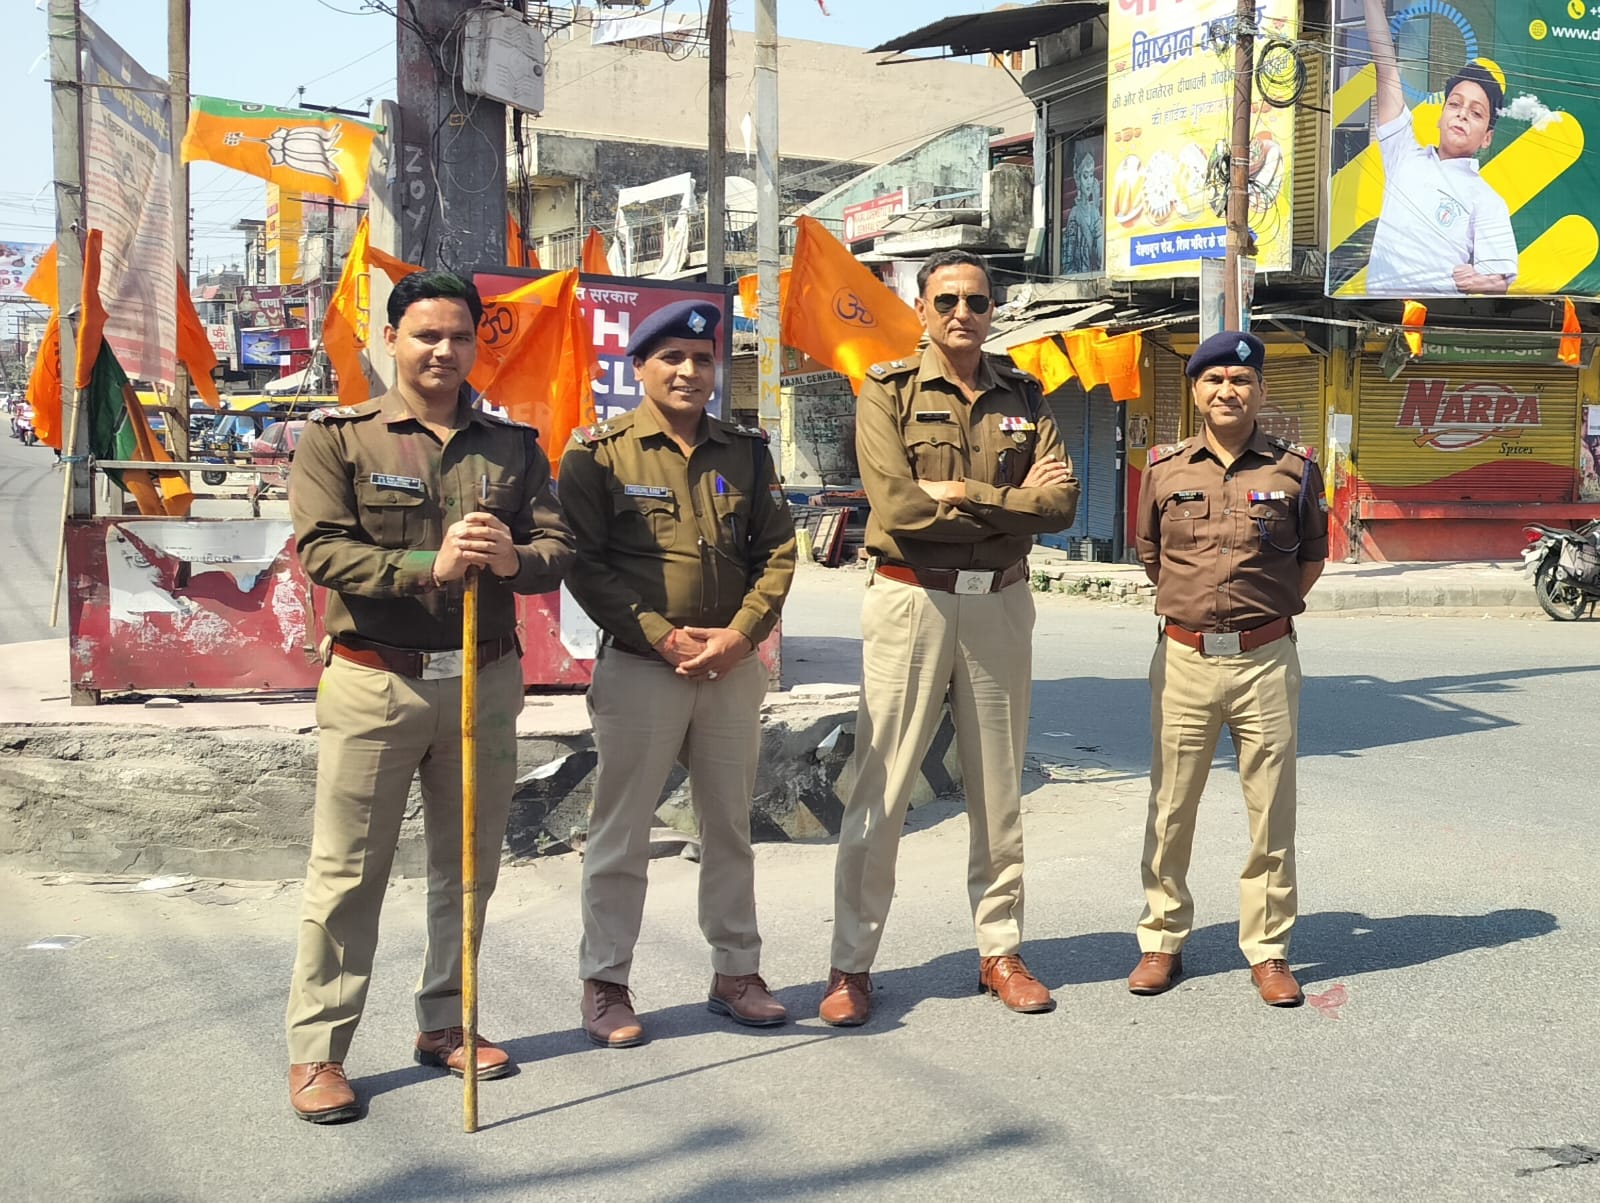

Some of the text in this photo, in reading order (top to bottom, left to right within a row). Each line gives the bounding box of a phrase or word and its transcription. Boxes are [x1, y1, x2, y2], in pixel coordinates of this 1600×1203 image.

[1132, 26, 1195, 71] मिष्ठान
[589, 288, 639, 306] सरकार
[780, 371, 842, 387] KAJAL GENERAL
[1397, 379, 1541, 427] NARPA
[1498, 442, 1534, 456] Spices
